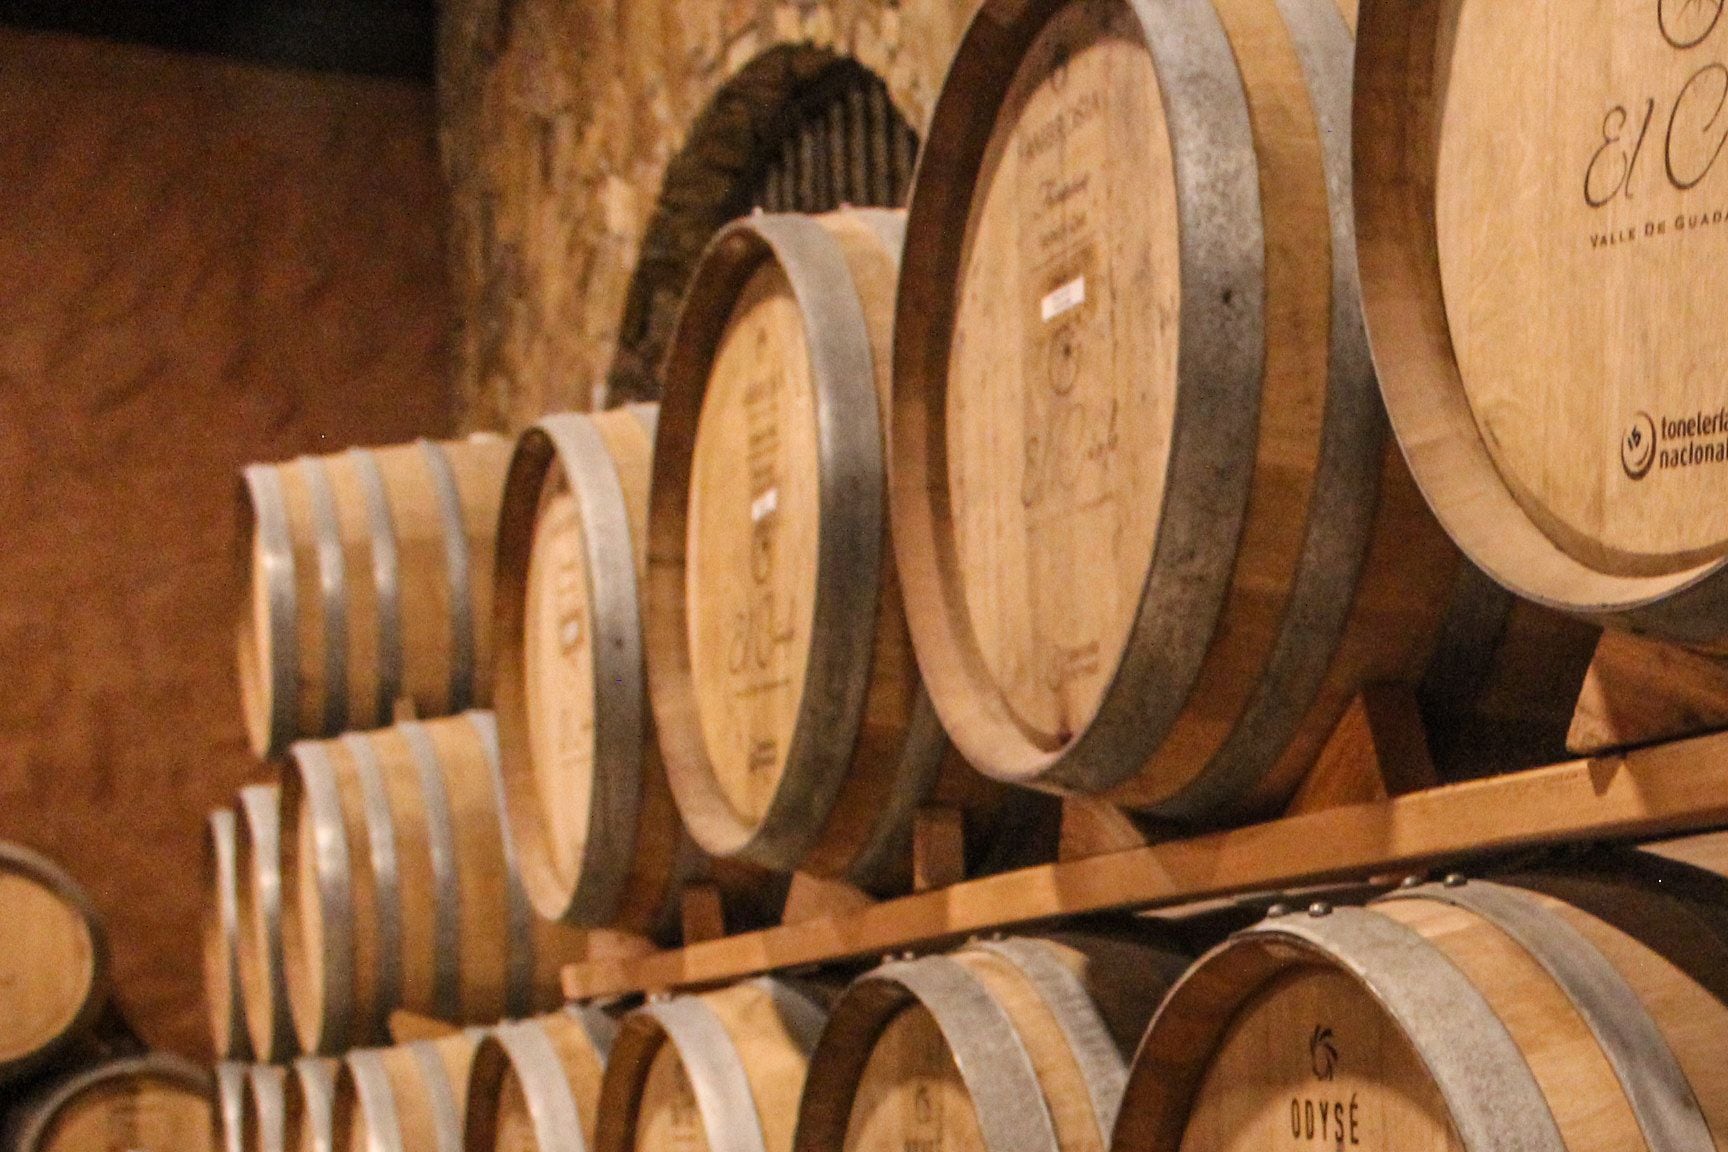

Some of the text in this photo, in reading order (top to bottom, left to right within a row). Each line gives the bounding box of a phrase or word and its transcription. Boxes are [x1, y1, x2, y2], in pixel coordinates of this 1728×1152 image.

[1583, 97, 1656, 208] El
[1589, 226, 1636, 249] VALLE
[1644, 220, 1667, 237] DE
